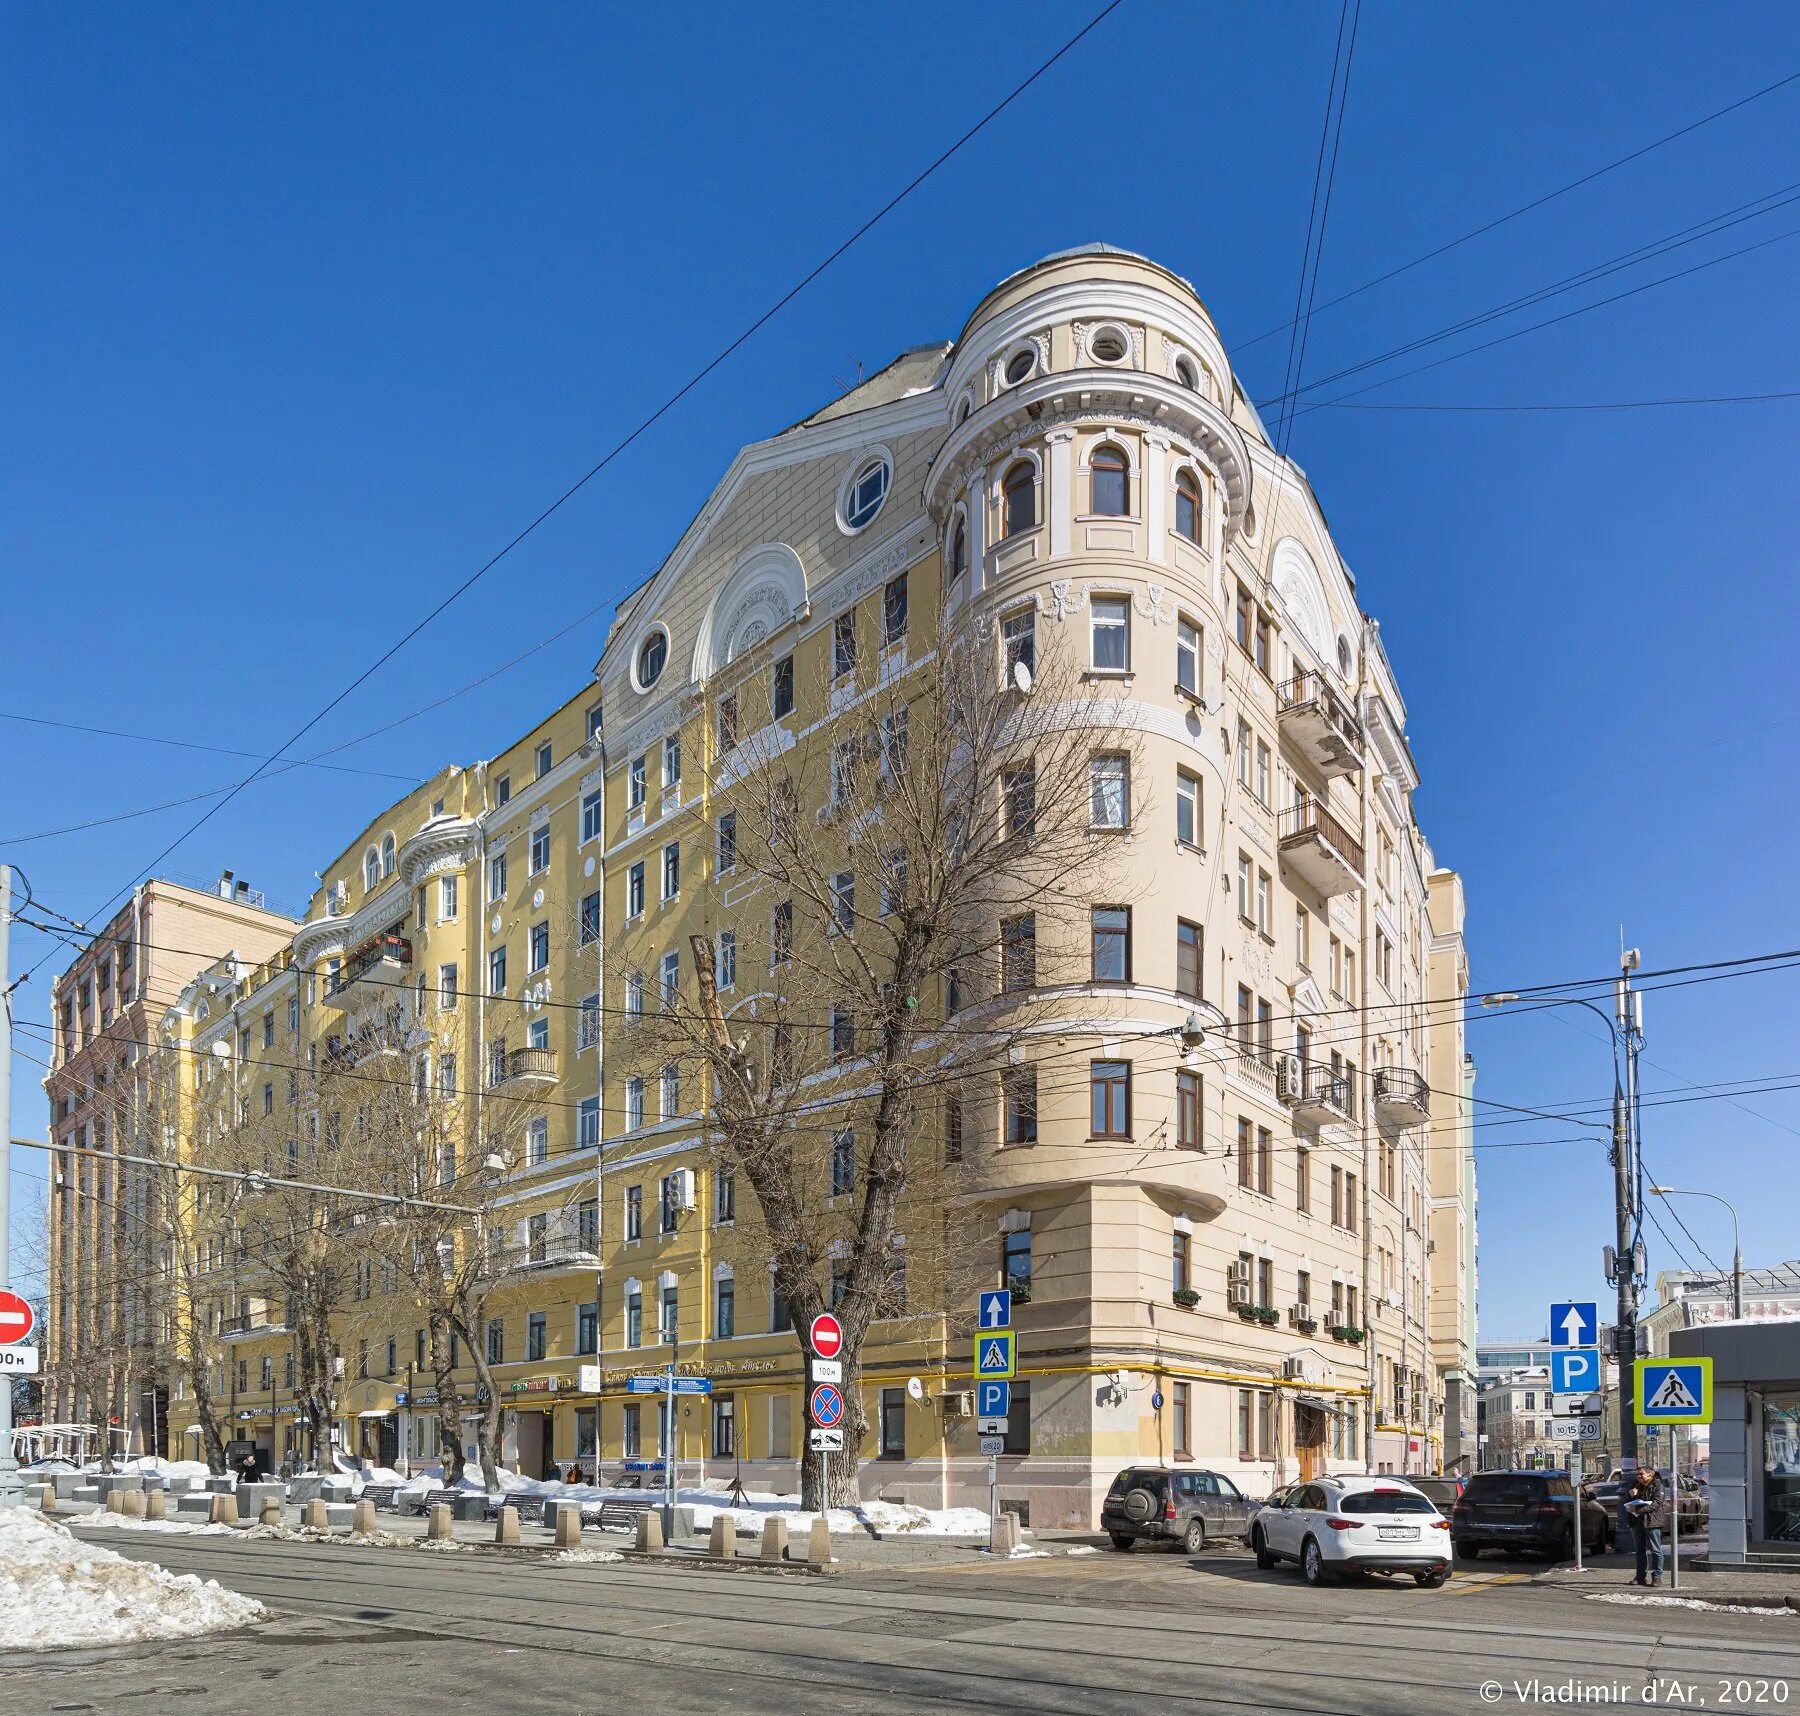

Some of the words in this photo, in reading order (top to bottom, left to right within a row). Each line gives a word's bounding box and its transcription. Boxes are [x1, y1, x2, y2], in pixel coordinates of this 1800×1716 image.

[1563, 1355, 1589, 1388] P
[985, 1385, 1002, 1412] P
[1567, 1426, 1577, 1434] 15
[1580, 1425, 1594, 1434] 20
